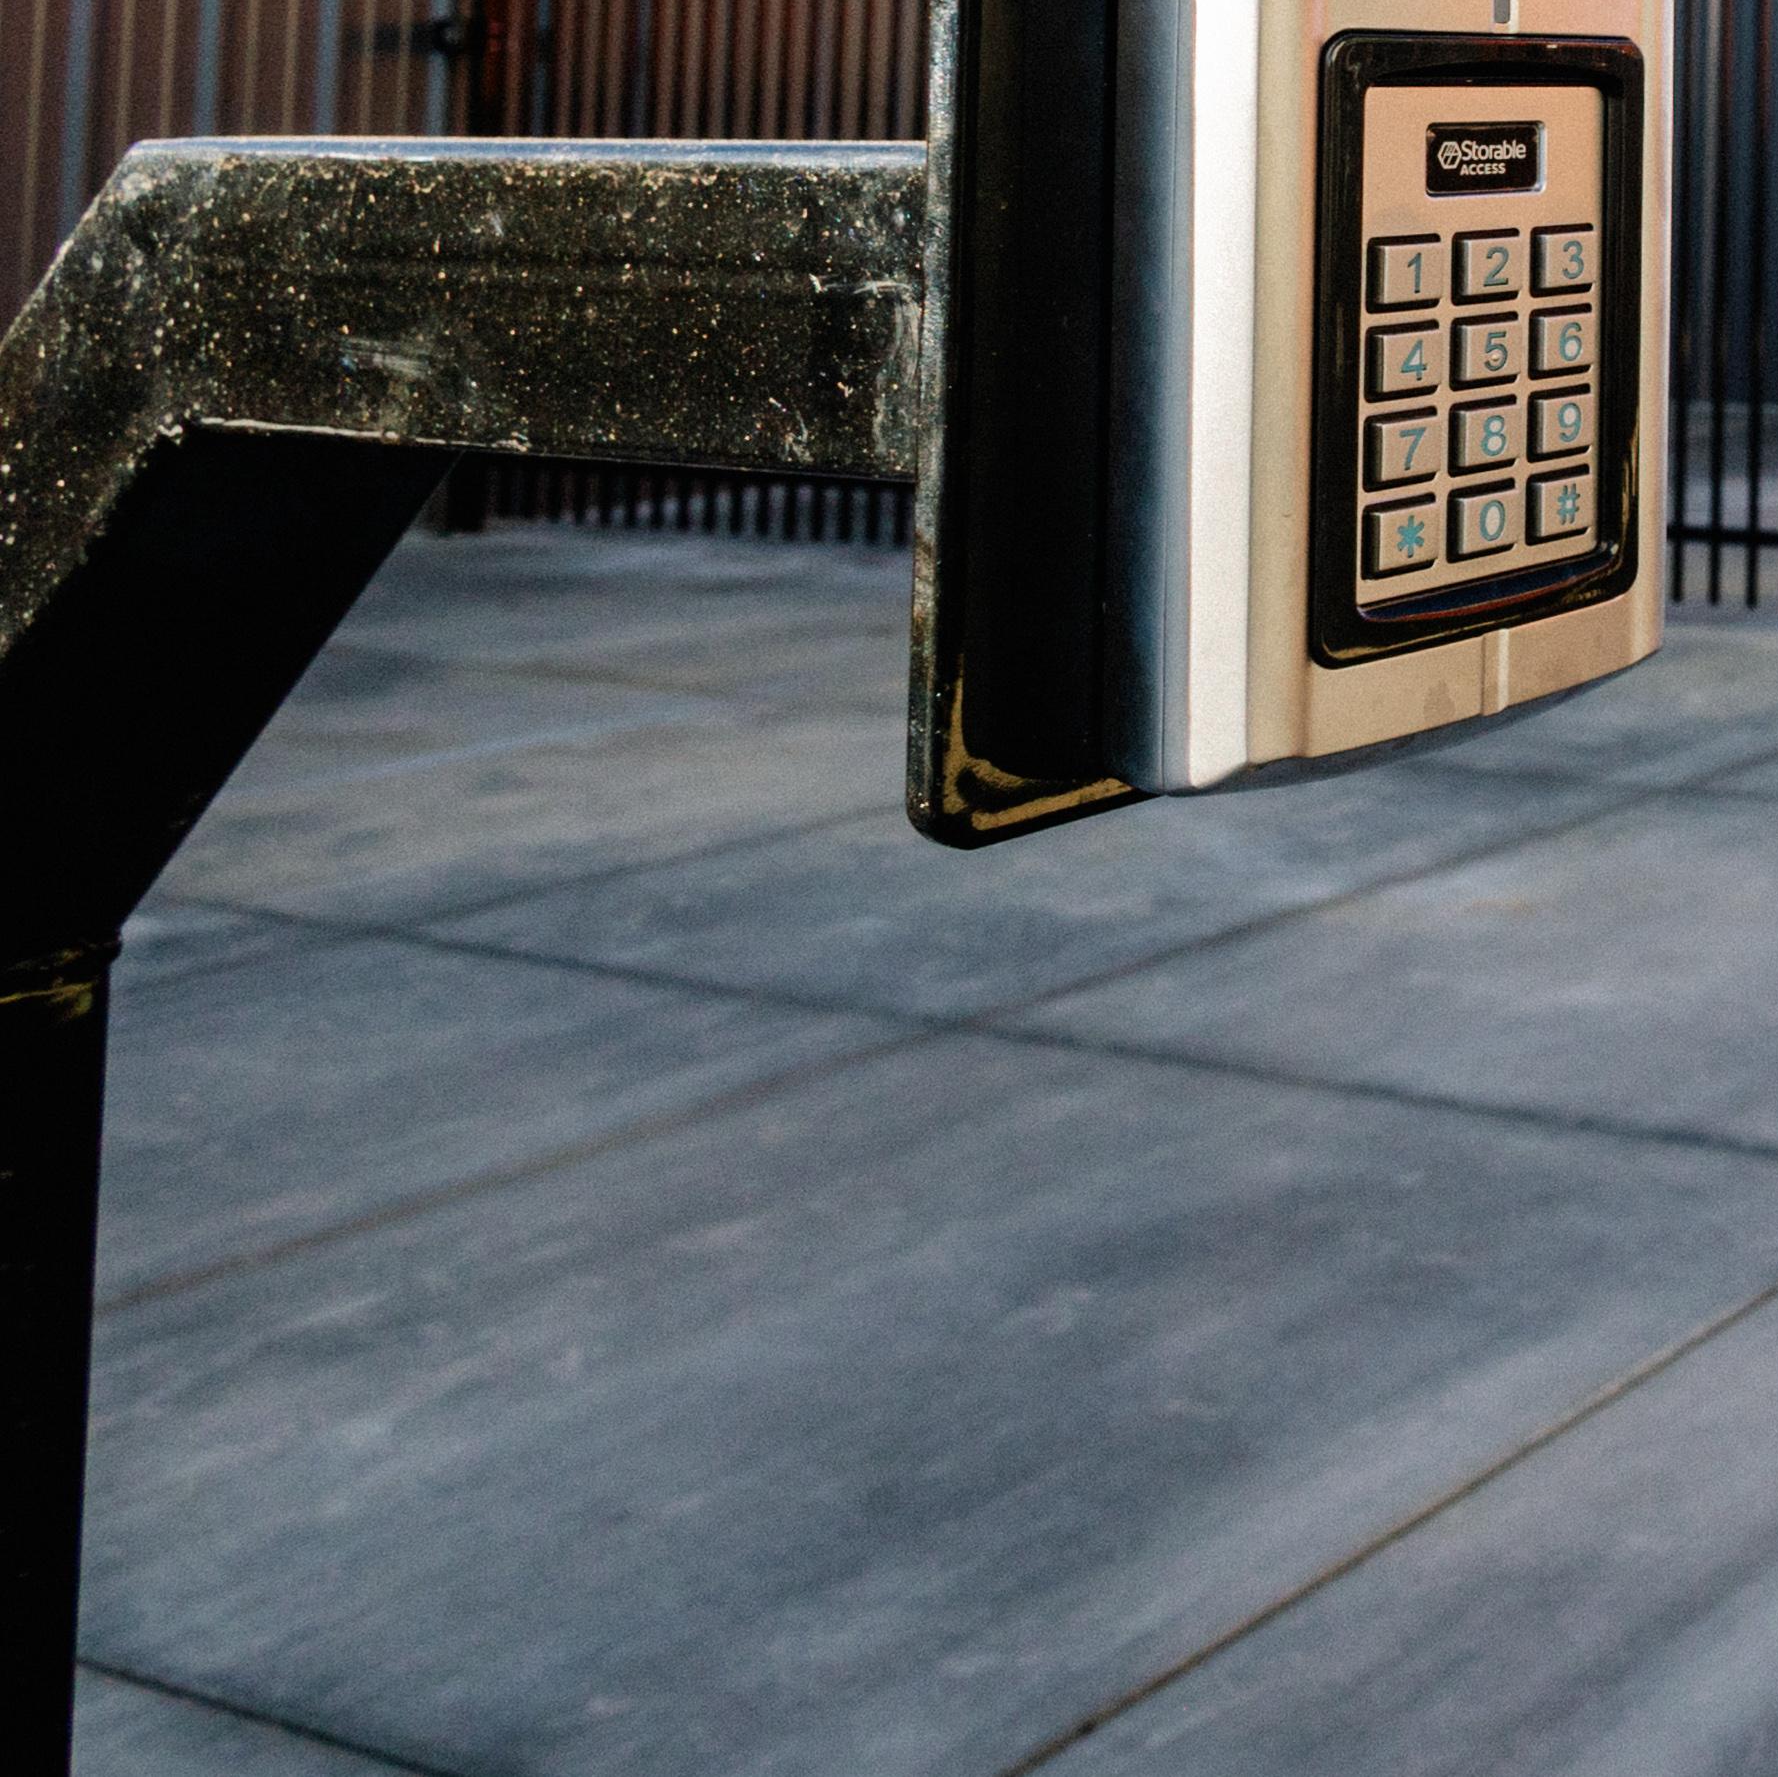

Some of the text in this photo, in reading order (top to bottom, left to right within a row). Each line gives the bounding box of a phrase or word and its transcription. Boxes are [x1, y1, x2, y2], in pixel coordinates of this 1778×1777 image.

[1460, 162, 1507, 176] ACCESS
[1461, 139, 1527, 161] Storable
[1406, 240, 1584, 294] 1 2 3
[1401, 322, 1583, 381] 4 5 6
[1400, 402, 1582, 470] 7 8 9
[1480, 498, 1506, 541] 0
[1556, 484, 1581, 526] #
